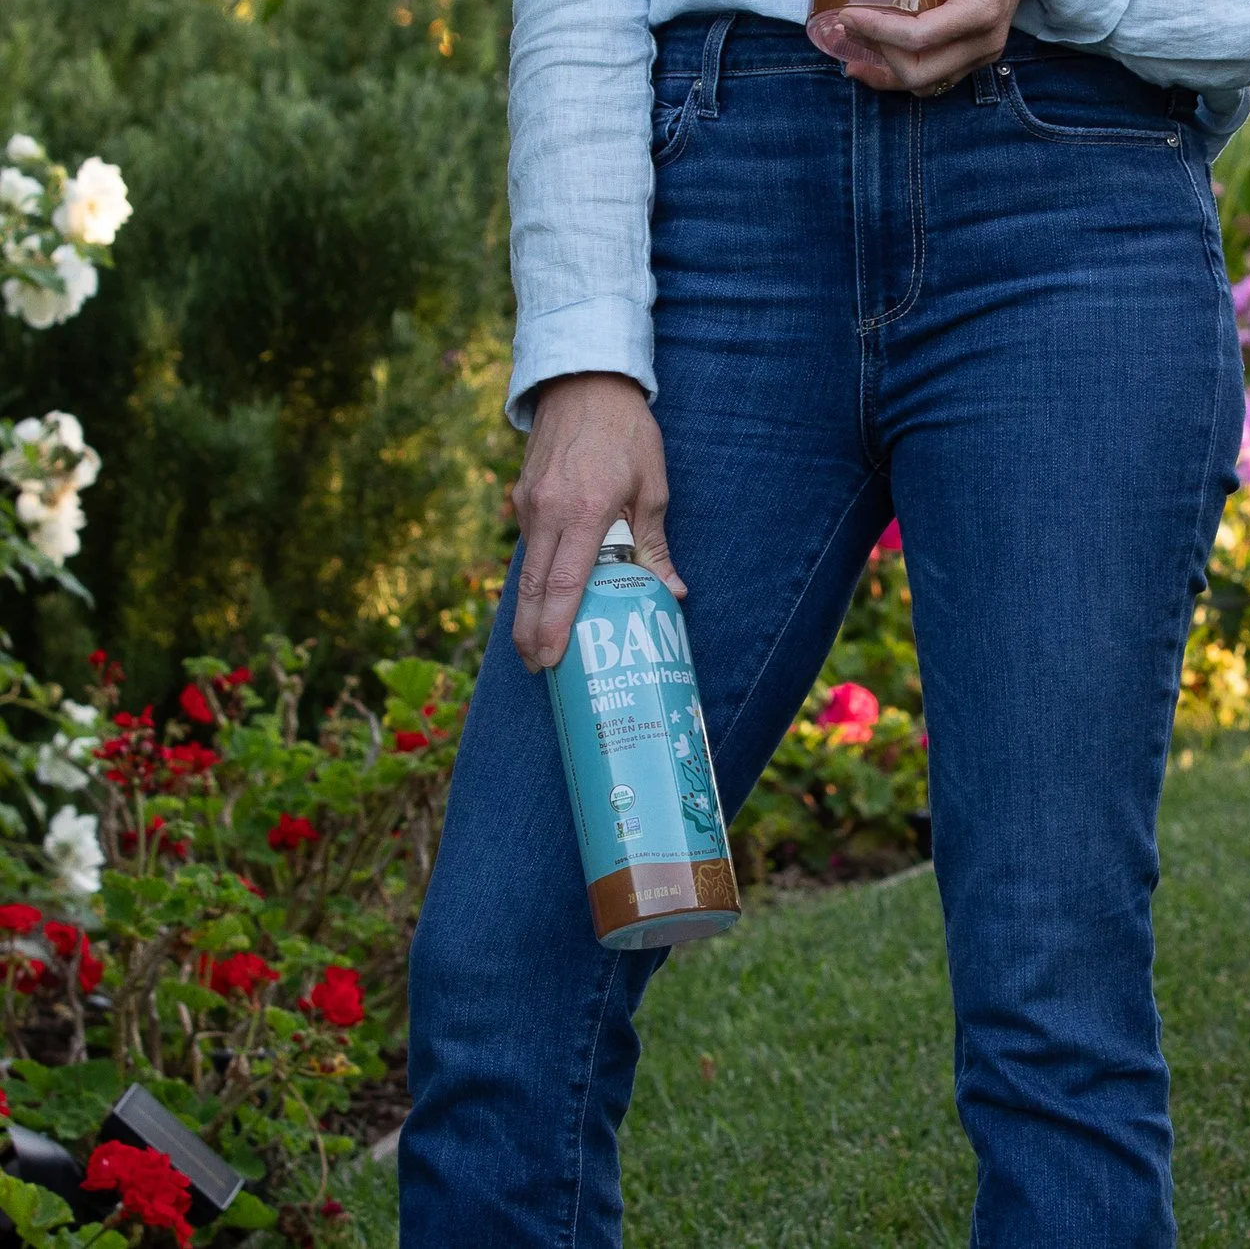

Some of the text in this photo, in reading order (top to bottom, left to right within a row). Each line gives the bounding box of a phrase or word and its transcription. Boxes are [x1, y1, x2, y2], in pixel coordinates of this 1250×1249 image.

[594, 575, 656, 587] Unsweetened
[612, 581, 647, 590] Vanilla
[575, 610, 692, 675] BAM
[586, 667, 696, 695] Buckwheat
[591, 691, 636, 714] Milk
[595, 715, 635, 731] DAIRY &
[597, 720, 662, 739] GLUTEN FREE
